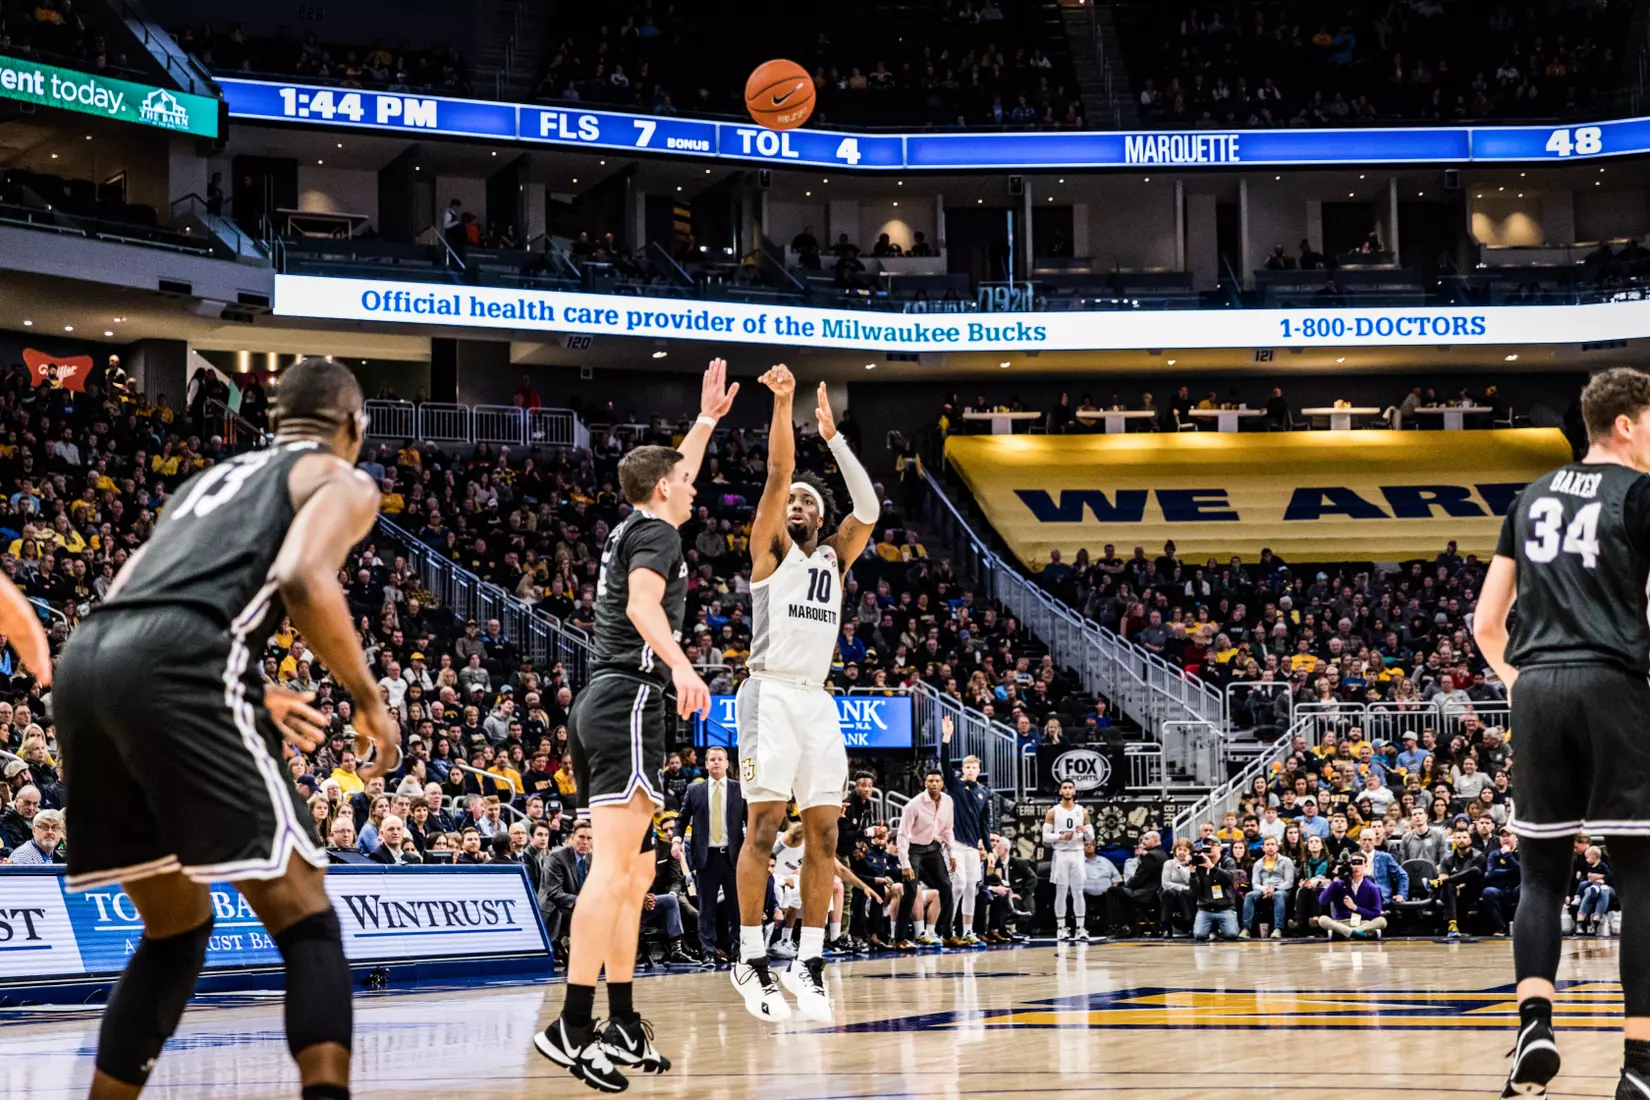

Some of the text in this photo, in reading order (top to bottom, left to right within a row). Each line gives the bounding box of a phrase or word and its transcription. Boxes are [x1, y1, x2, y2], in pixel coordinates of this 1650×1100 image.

[0, 68, 126, 114] ent today.
[139, 109, 160, 122] THE
[162, 114, 189, 127] BARN
[279, 87, 437, 128] 1:44 PM
[539, 112, 709, 151] FLS 7 BONUS
[736, 128, 861, 165] TOL 4
[1545, 126, 1603, 157] 48
[1124, 134, 1240, 163] MARQUETTE
[361, 289, 1047, 342] Official health care provider of the Milwaukee Bucks
[1280, 316, 1486, 338] 1-800-DOCTORS
[566, 336, 592, 349] 120
[1255, 351, 1274, 362] 121
[1013, 489, 1240, 522] WE
[1525, 497, 1602, 568] 34
[807, 568, 832, 603] 10
[788, 604, 837, 625] MARQUETT
[1065, 758, 1097, 774] FOX
[1066, 817, 1074, 829] 0
